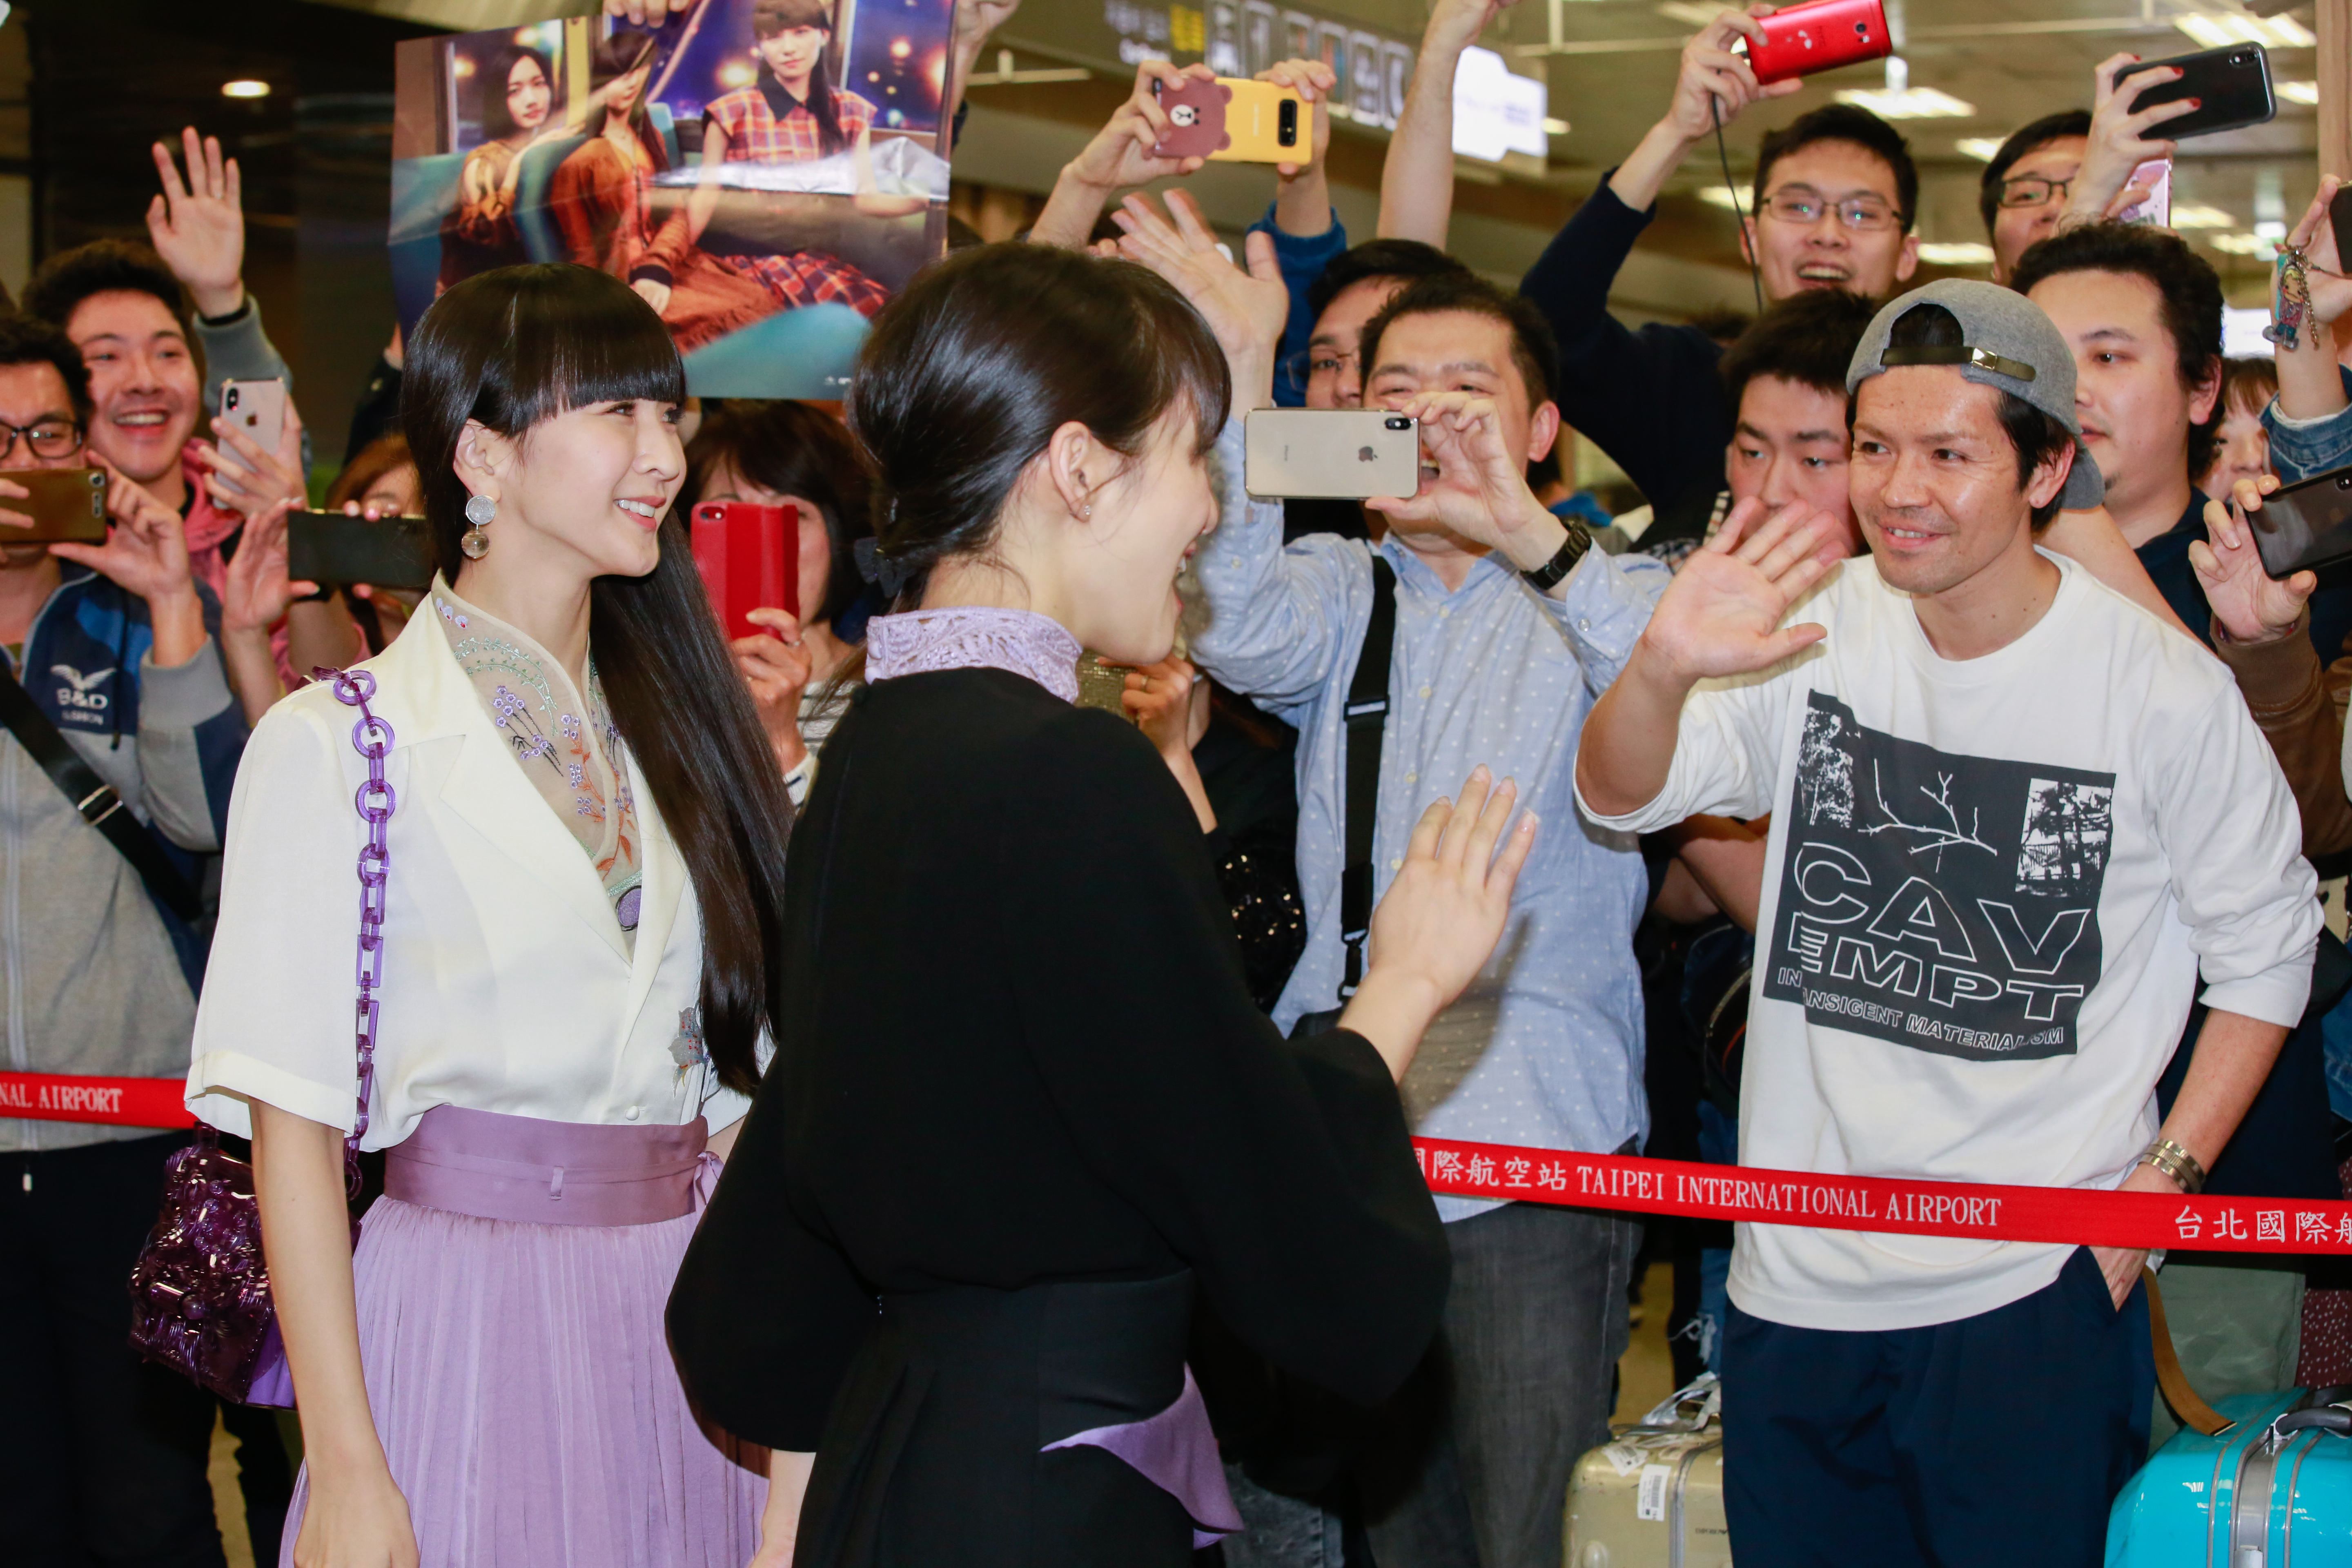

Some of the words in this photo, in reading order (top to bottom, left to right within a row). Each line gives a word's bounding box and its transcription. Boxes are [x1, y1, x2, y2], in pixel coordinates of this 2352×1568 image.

[57, 688, 108, 710] B&D
[1794, 842, 2091, 975] CAV
[1788, 911, 2084, 1021] EMPT
[1906, 1013, 2064, 1051] MATERIALSM
[39, 1085, 122, 1114] AIRPORT
[1577, 1165, 1664, 1200] TAIPEI
[1676, 1175, 1876, 1218] INTERNATIONAL
[1885, 1193, 2002, 1226] AIRPORT
